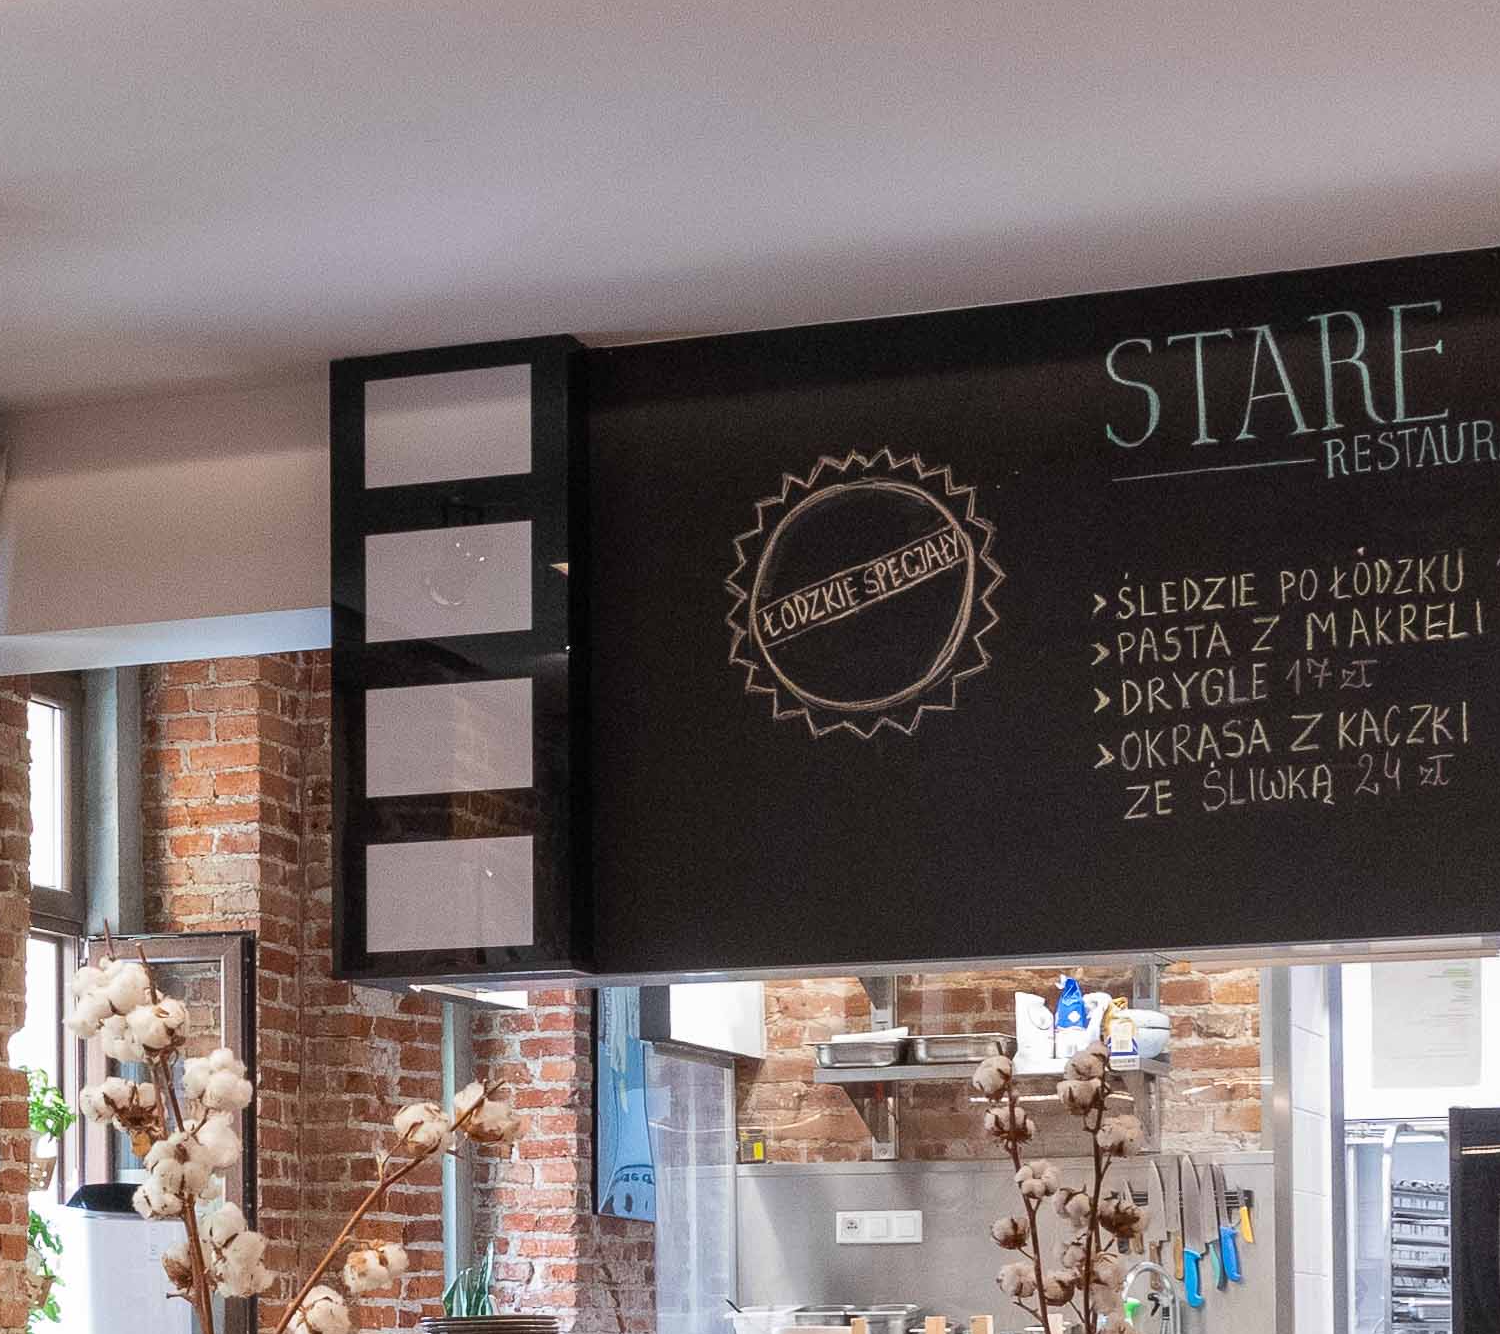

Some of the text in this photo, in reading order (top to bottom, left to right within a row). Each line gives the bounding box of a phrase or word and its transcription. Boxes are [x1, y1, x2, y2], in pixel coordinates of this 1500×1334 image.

[1105, 301, 1449, 448] STARE
[863, 529, 960, 595] SPECJAŁY
[1117, 571, 1258, 619] ŚLEDZIE
[1279, 568, 1318, 605] PO
[1328, 546, 1464, 601] ŁÓDZKU
[1117, 622, 1231, 665] PASTA
[1251, 616, 1280, 652] Z
[1306, 599, 1485, 651] MAKRELI
[1121, 663, 1268, 716] DRYGLE
[1285, 660, 1333, 695] 17
[1119, 700, 1470, 773] OKRASA Z KACZKI
[1123, 779, 1174, 820] ZE
[1202, 761, 1336, 812] ŚLIWKĄ
[1354, 754, 1402, 795] 24
